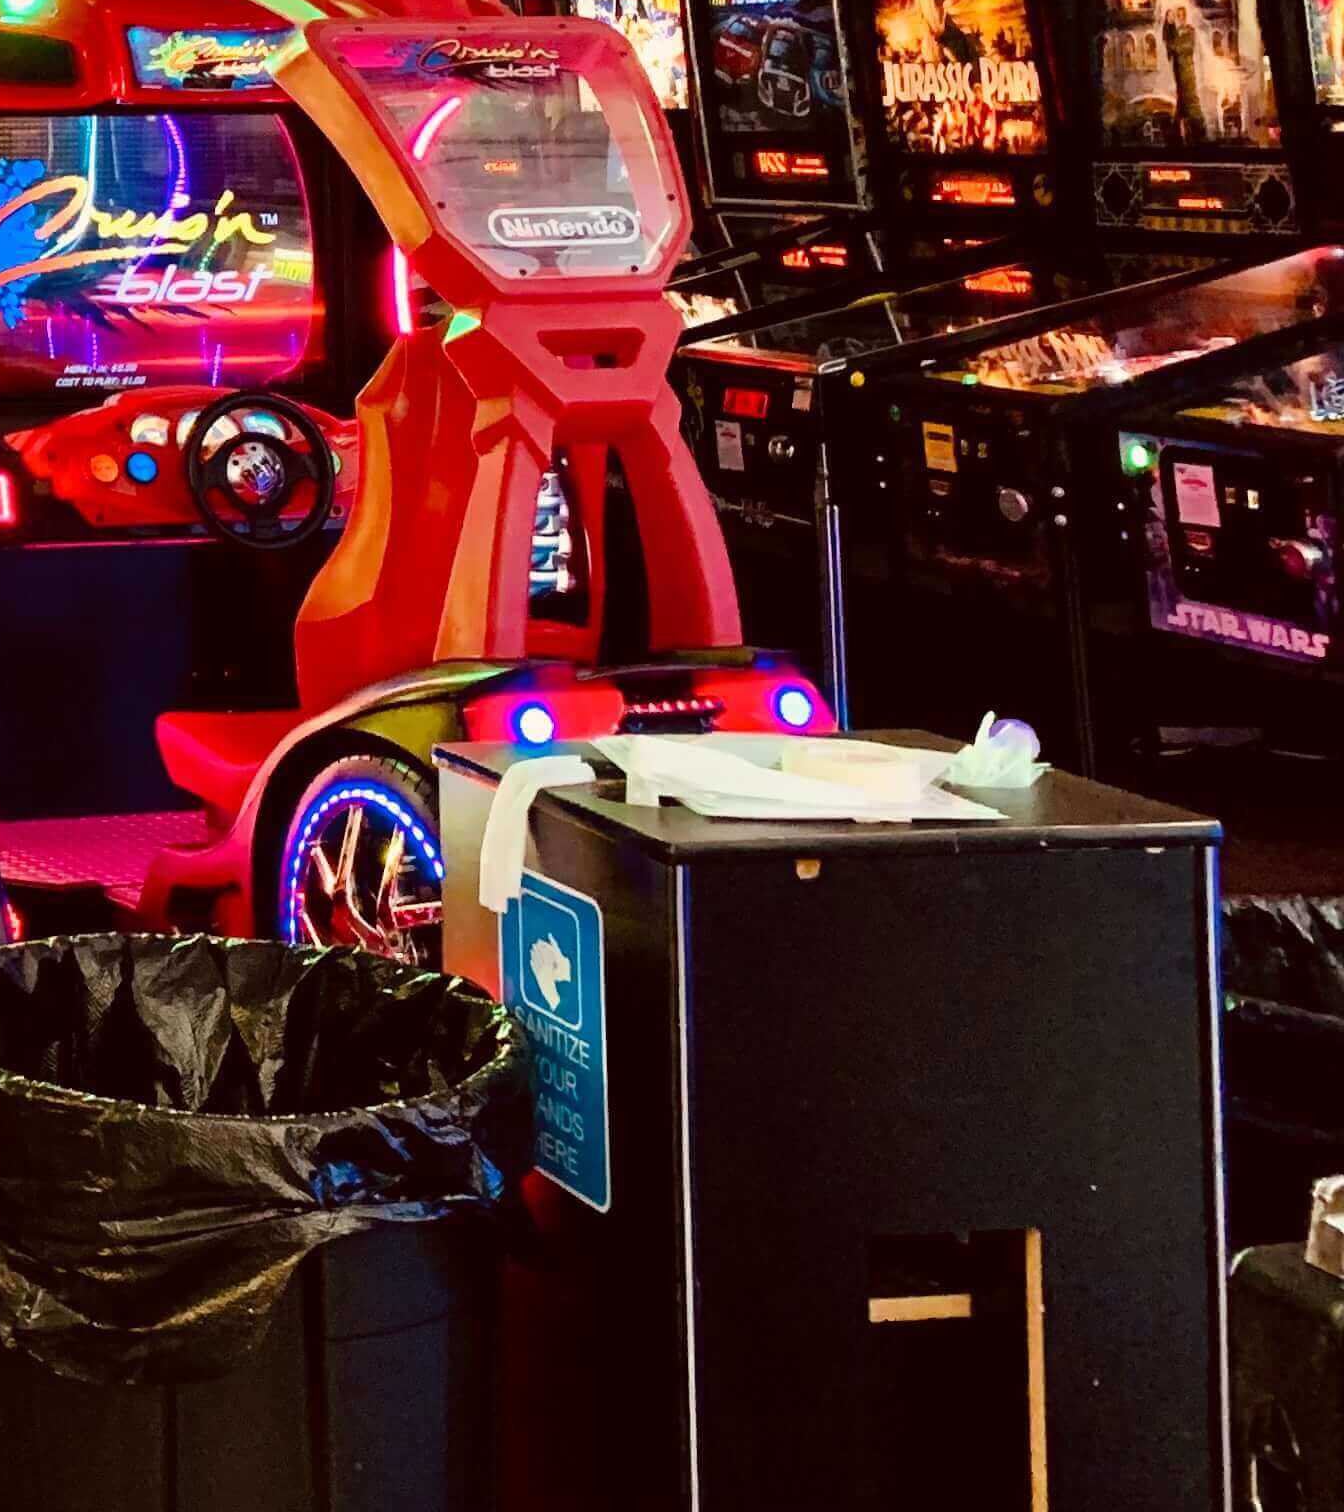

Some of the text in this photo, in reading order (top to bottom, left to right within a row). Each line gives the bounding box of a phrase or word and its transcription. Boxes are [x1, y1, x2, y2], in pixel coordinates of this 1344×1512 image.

[486, 63, 562, 79] blast
[882, 60, 974, 107] JURASSIC
[259, 213, 278, 225] TM
[501, 216, 626, 238] Nintendo
[90, 263, 276, 304] blast
[1167, 603, 1330, 658] STAR WARS
[514, 1005, 591, 1071] SANITIZE
[536, 1053, 579, 1102] OUR
[535, 1092, 585, 1142] ANDS
